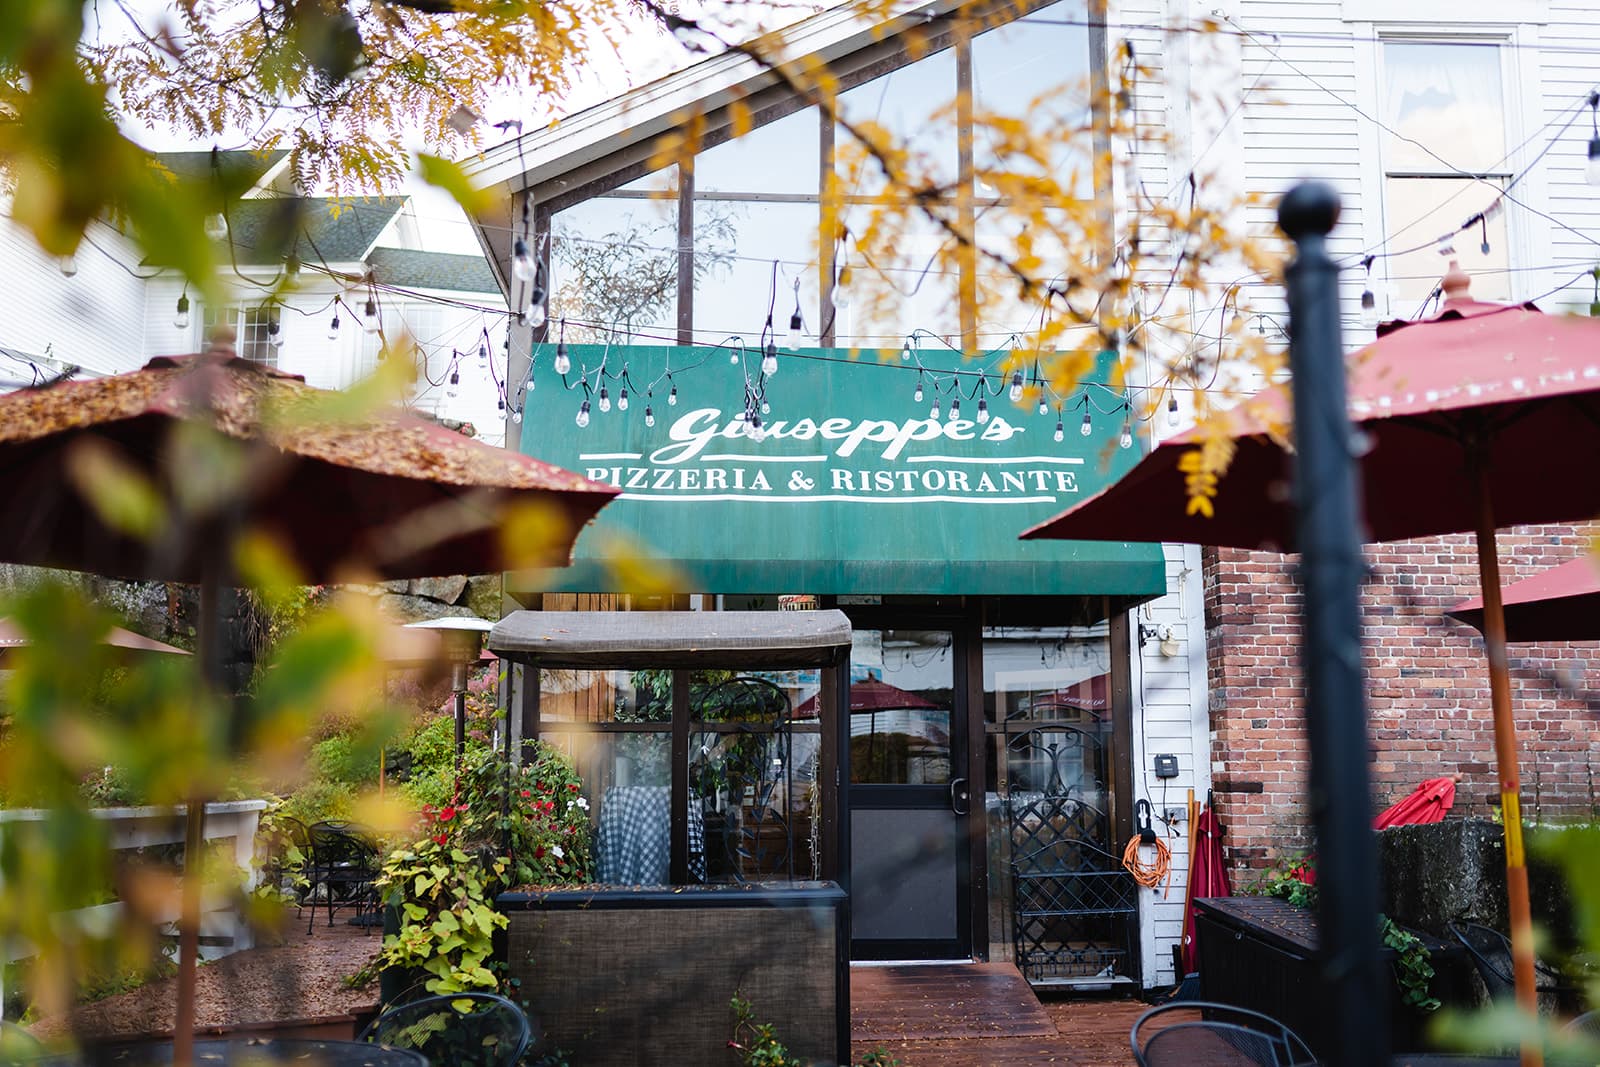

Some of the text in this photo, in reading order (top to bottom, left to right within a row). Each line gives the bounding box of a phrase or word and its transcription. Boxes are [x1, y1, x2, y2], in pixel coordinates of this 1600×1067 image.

[586, 467, 1079, 493] PIZZERIA & RISTORANTE
